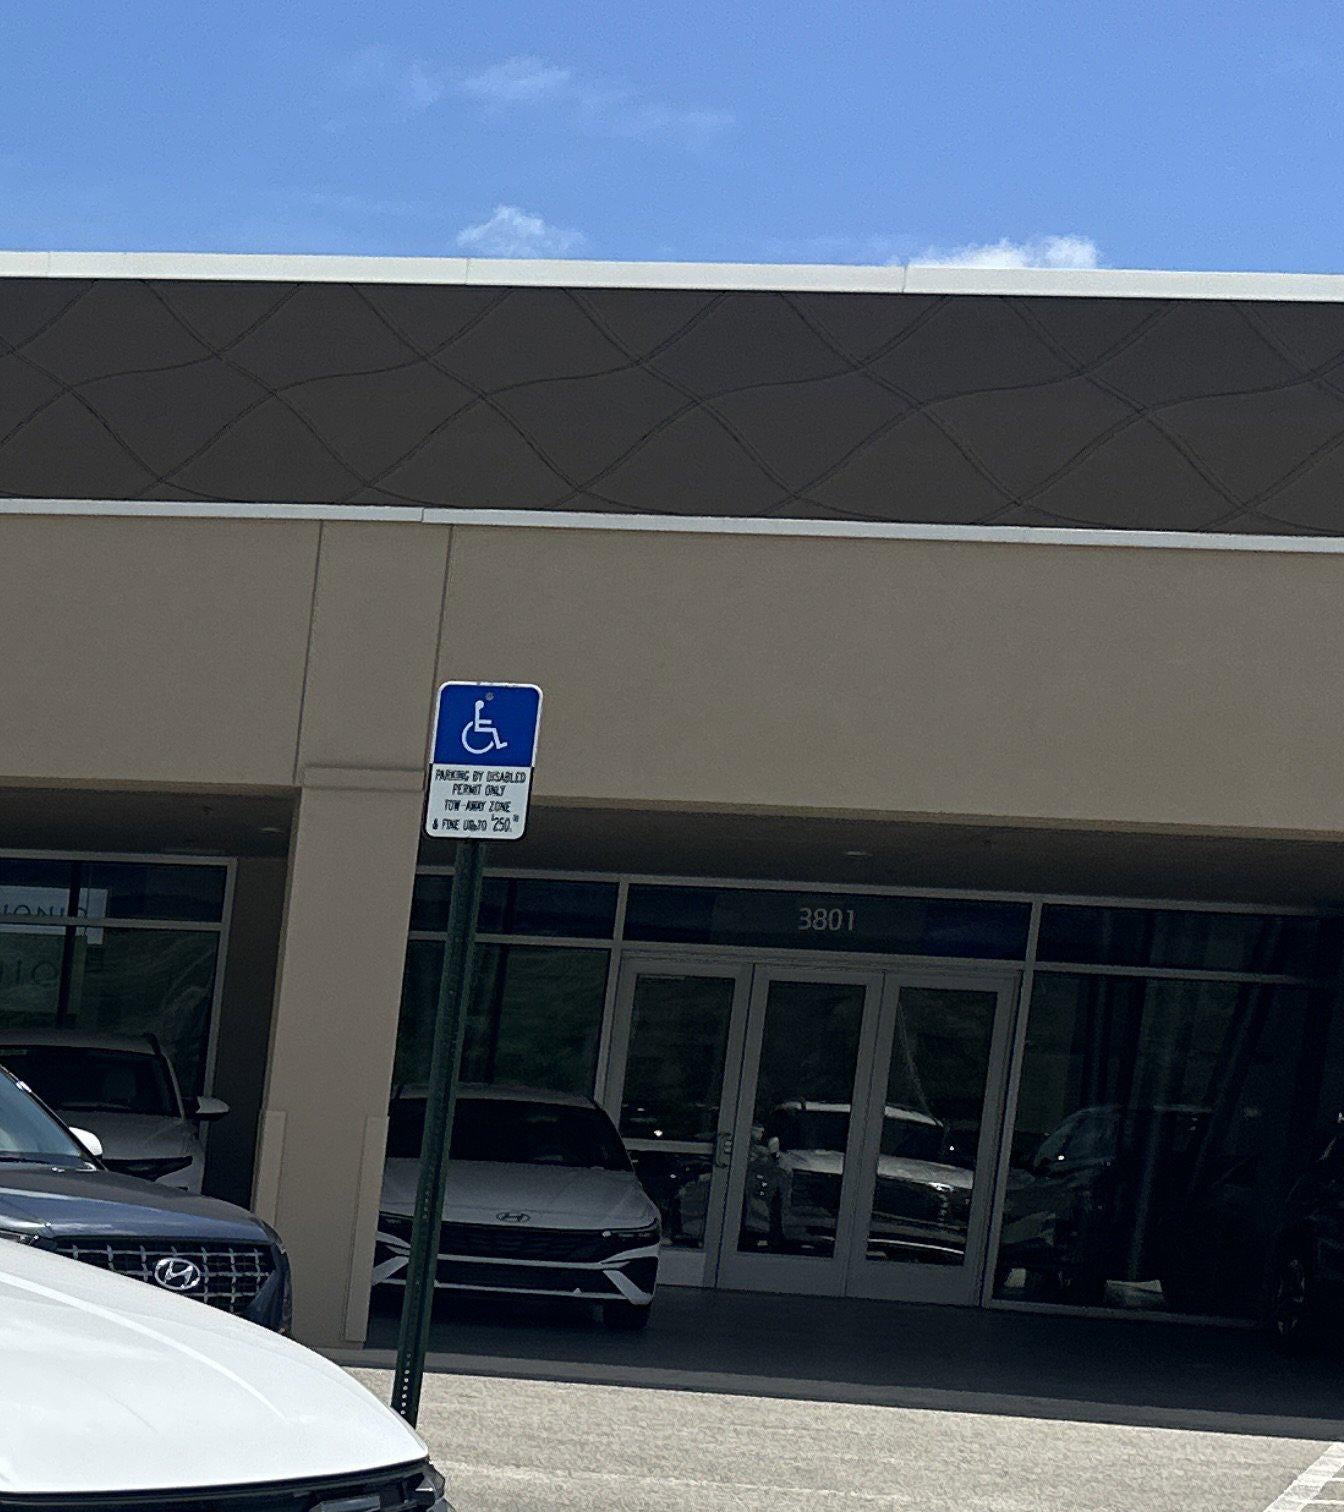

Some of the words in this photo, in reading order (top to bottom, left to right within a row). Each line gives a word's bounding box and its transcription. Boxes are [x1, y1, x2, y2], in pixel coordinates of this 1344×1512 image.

[434, 769, 469, 781] PARKING
[472, 770, 484, 782] BY
[486, 770, 526, 783] DISABLED
[452, 783, 482, 795] PERMIT
[484, 784, 506, 796] ONLY
[488, 800, 511, 812] ZONE
[442, 818, 460, 831] FINE
[798, 907, 856, 931] 3801
